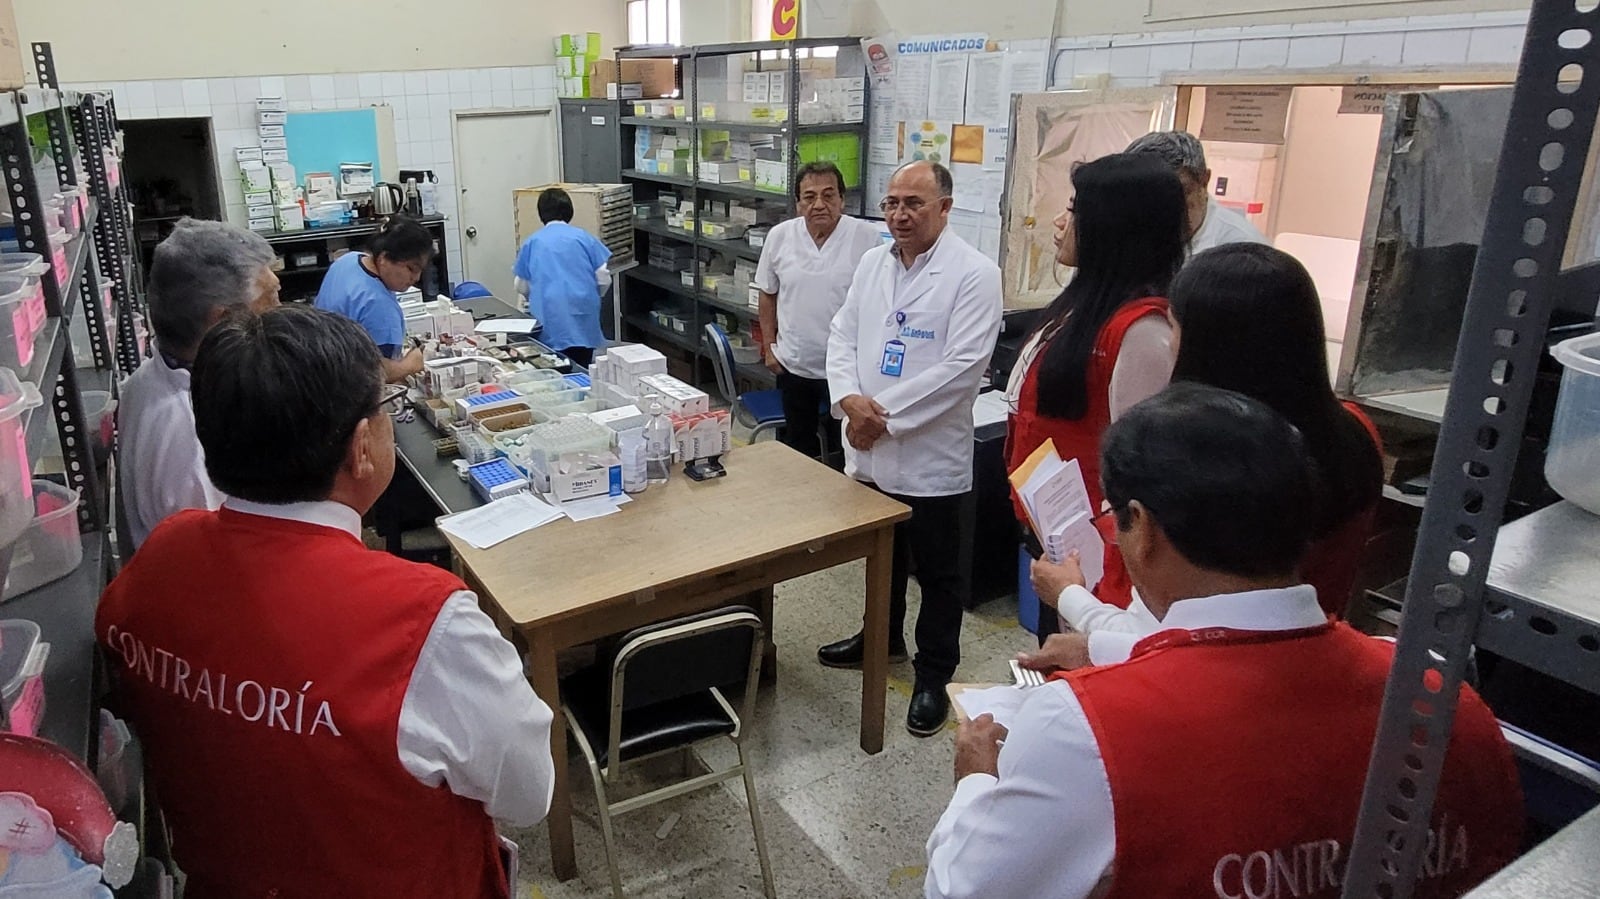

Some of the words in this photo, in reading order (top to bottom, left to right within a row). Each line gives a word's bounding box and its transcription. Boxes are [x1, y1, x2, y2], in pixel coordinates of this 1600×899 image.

[772, 0, 795, 36] C
[897, 38, 985, 54] COMUNICADOS
[107, 624, 342, 737] CONTRALORÍA
